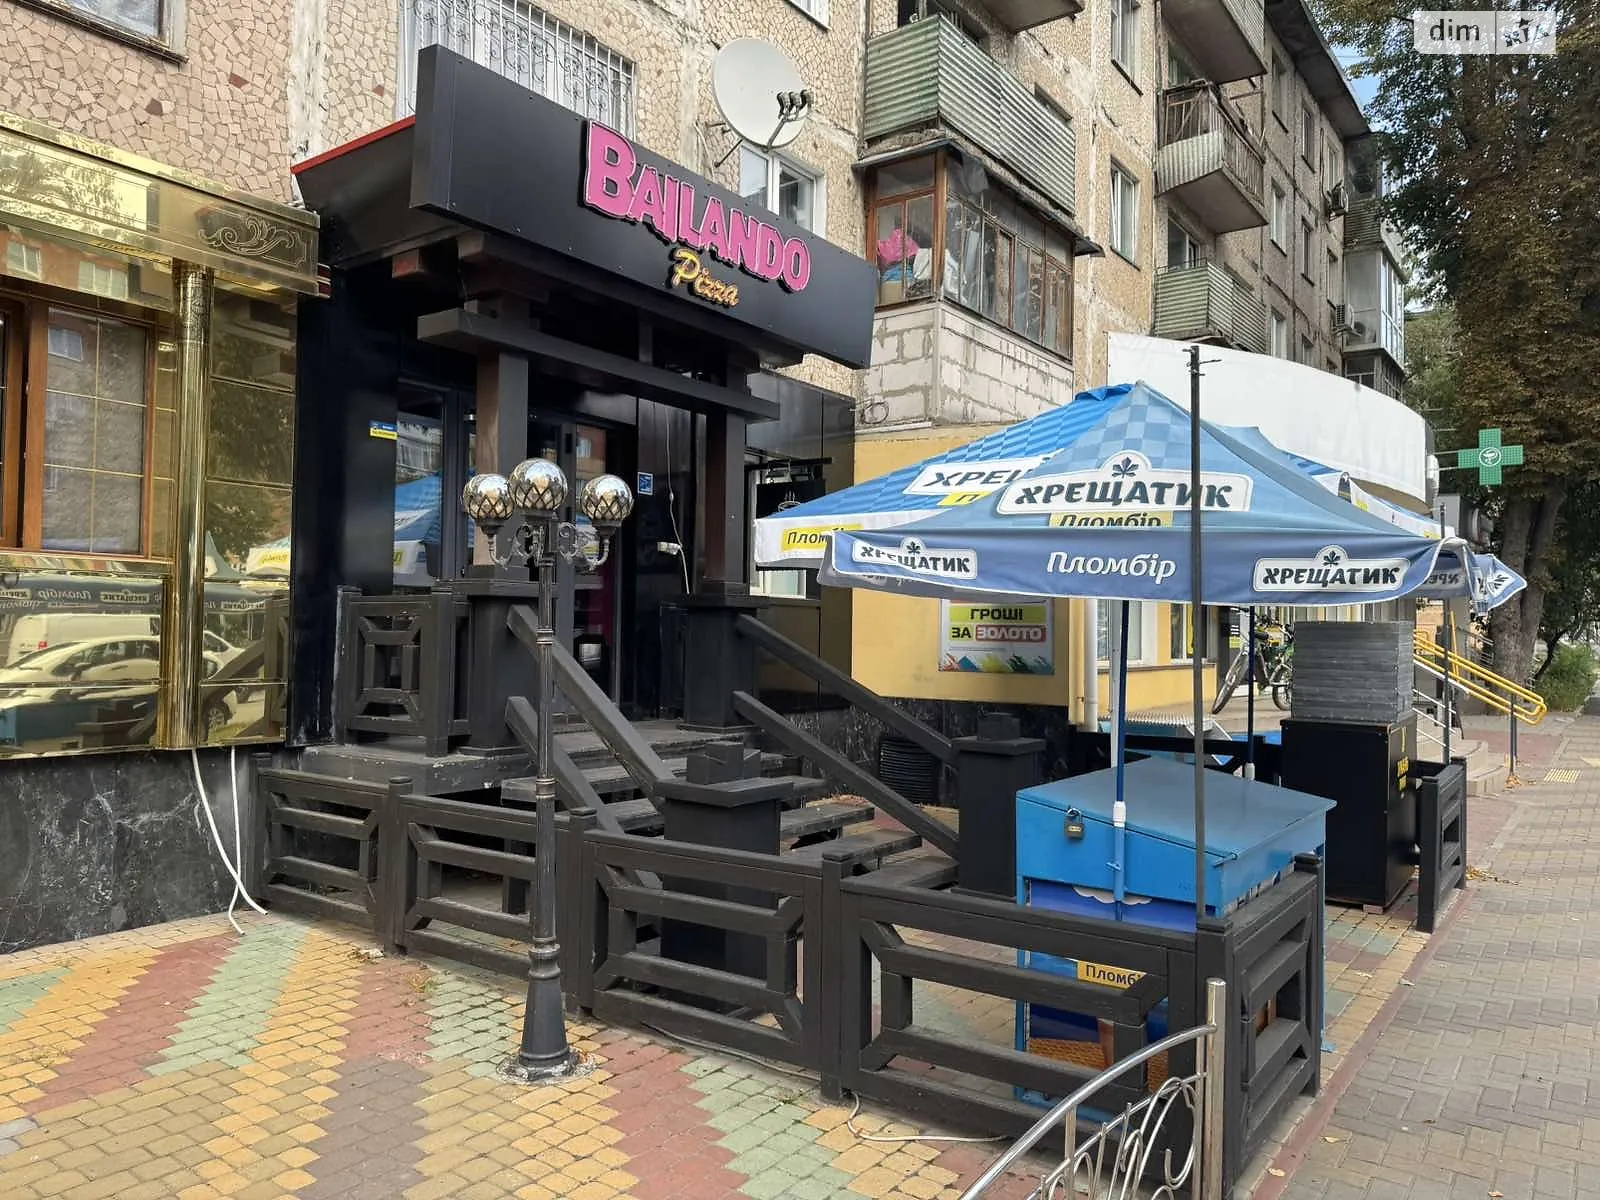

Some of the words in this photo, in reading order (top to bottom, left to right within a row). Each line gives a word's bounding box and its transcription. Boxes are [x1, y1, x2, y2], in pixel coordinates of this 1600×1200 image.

[585, 119, 811, 292] BAILANDO
[671, 248, 739, 307] Pizza
[1014, 480, 1233, 508] ХРЕЩАТИК
[1046, 551, 1177, 585] Пломбір
[1262, 567, 1400, 588] ХРЕЩАТИК
[970, 608, 1023, 620] ГРОШІ
[952, 626, 972, 639] ЗА
[976, 626, 1042, 640] ЗОЛОТО
[1086, 964, 1141, 985] Пломб
